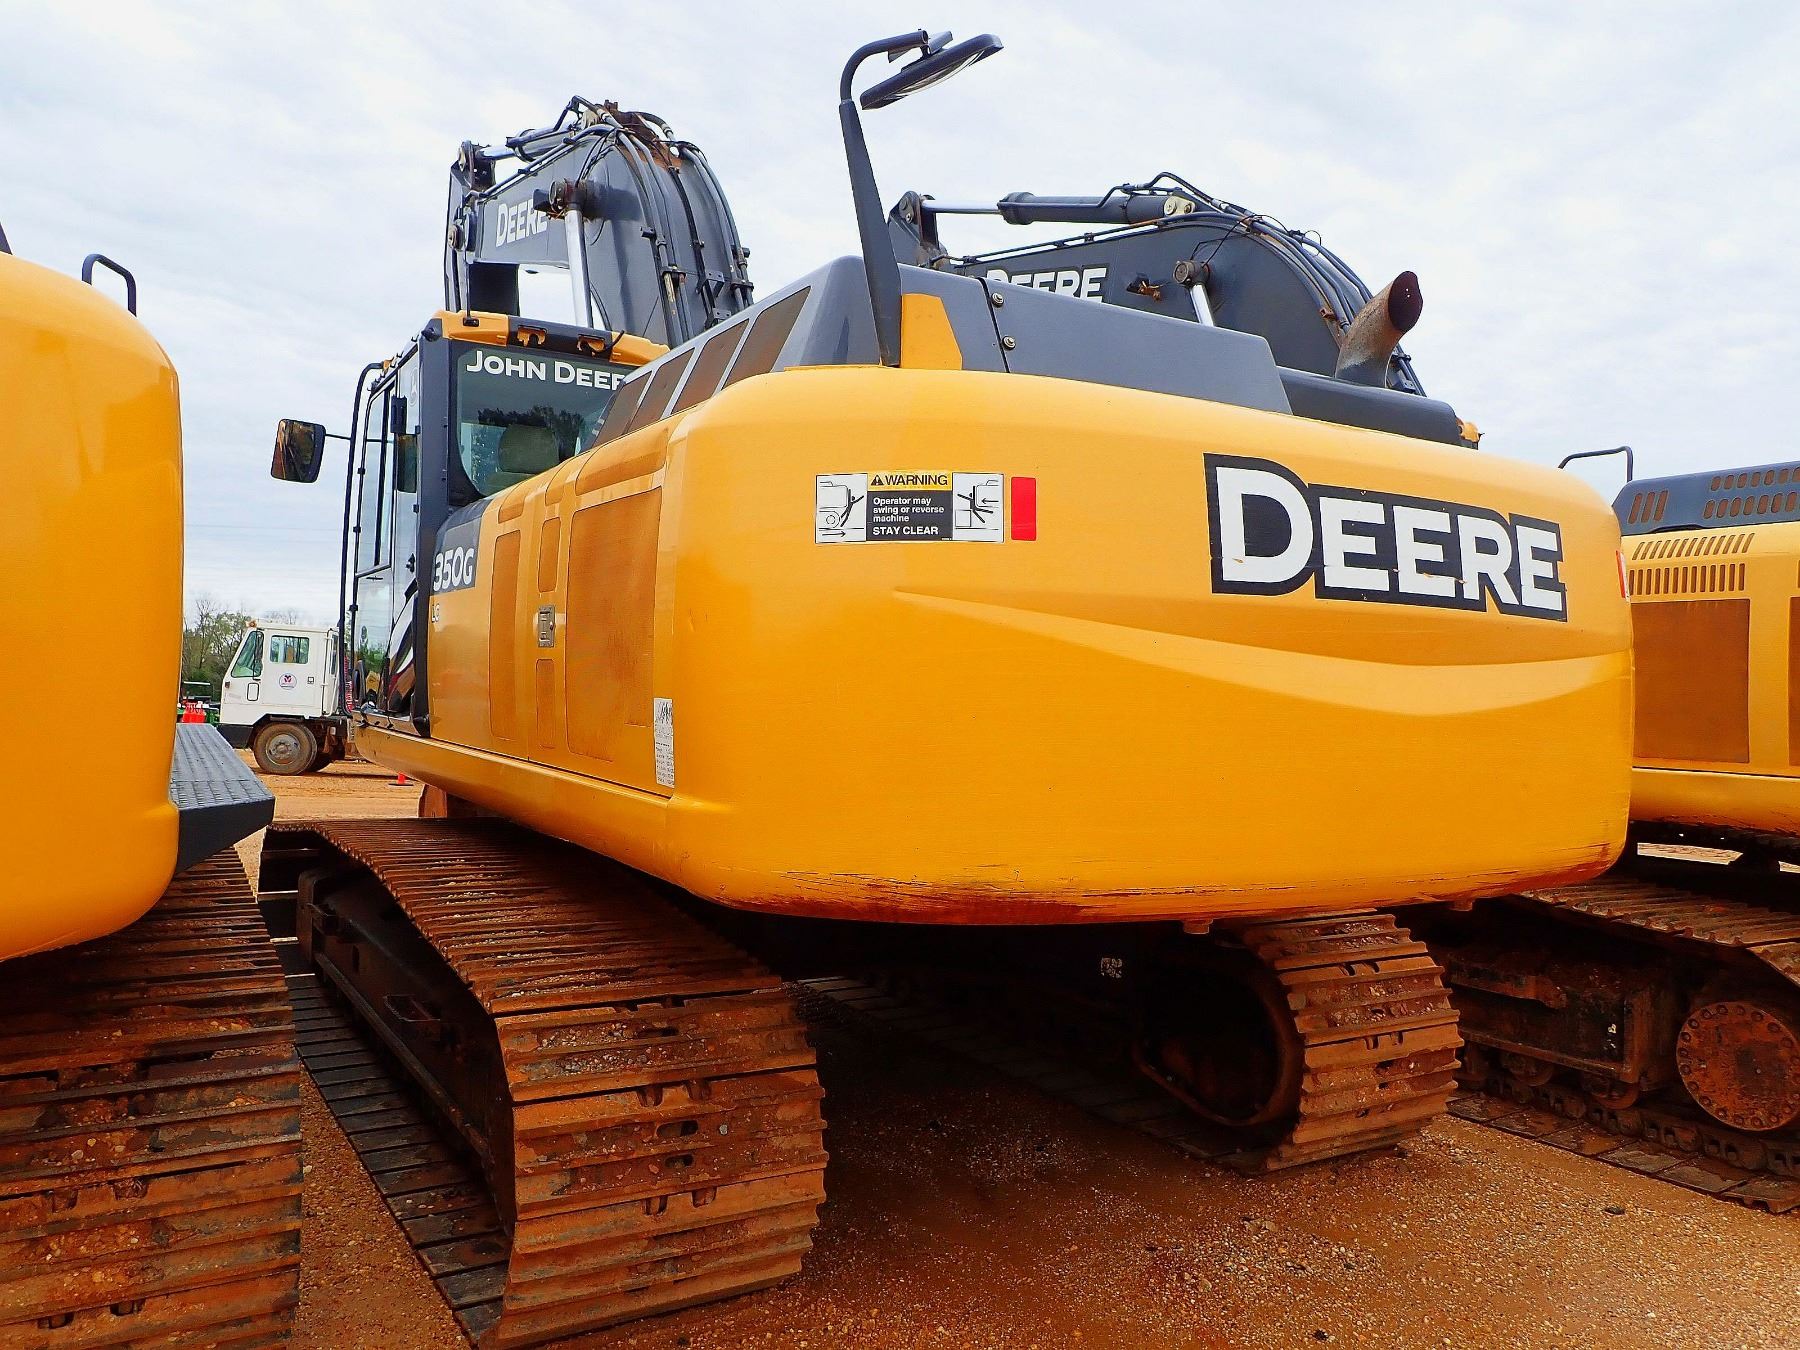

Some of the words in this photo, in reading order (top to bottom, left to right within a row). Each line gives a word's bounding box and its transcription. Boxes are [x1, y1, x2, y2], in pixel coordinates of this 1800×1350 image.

[496, 199, 548, 248] DEERE
[987, 267, 1107, 303] ERE
[466, 350, 546, 381] JOHN
[554, 361, 626, 391] DEER
[885, 474, 948, 486] WARNING
[873, 497, 911, 507] Operator
[912, 497, 932, 507] may
[873, 505, 899, 515] swing
[900, 506, 910, 514] or
[911, 506, 945, 514] reverse
[873, 514, 910, 523] machine
[872, 526, 900, 536] STAY
[902, 526, 939, 536] CLEAR
[1215, 466, 1563, 612] DEERE
[433, 546, 475, 592] 350G
